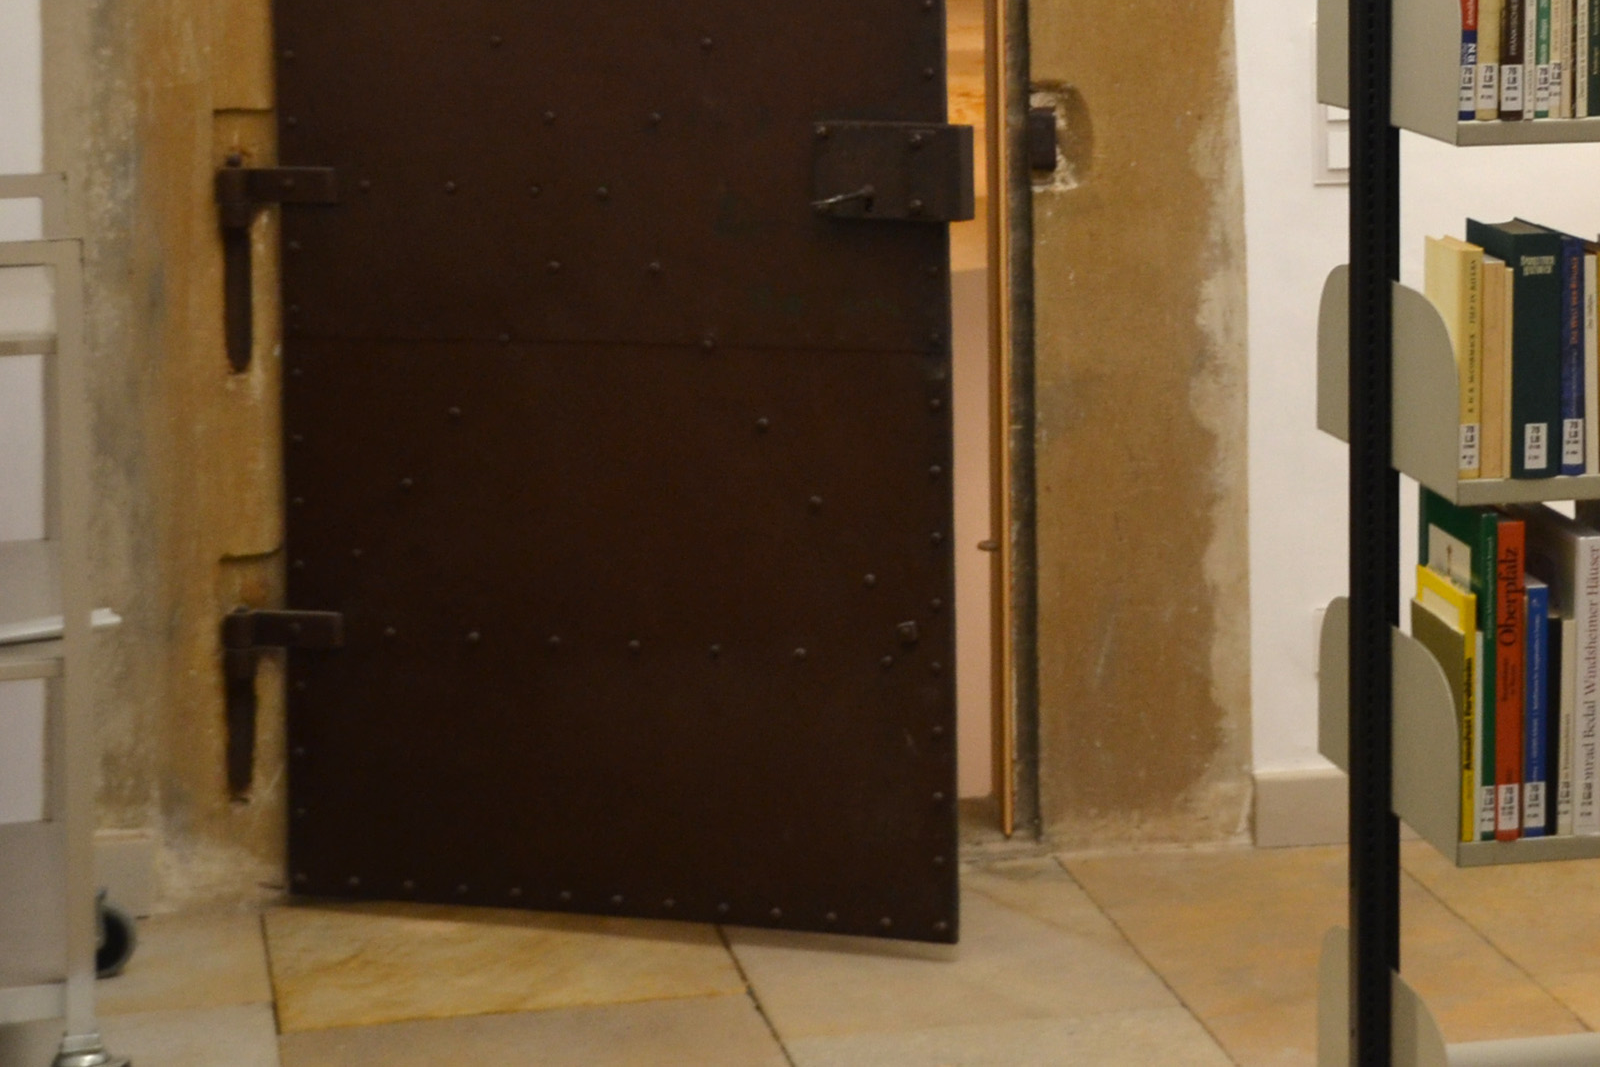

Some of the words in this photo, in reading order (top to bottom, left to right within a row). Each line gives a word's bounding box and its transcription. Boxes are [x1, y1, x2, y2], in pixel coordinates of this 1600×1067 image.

[1497, 546, 1521, 647] Oberpfalz
[1585, 545, 1600, 596] Häuser
[1583, 601, 1599, 696] Windsheimer
